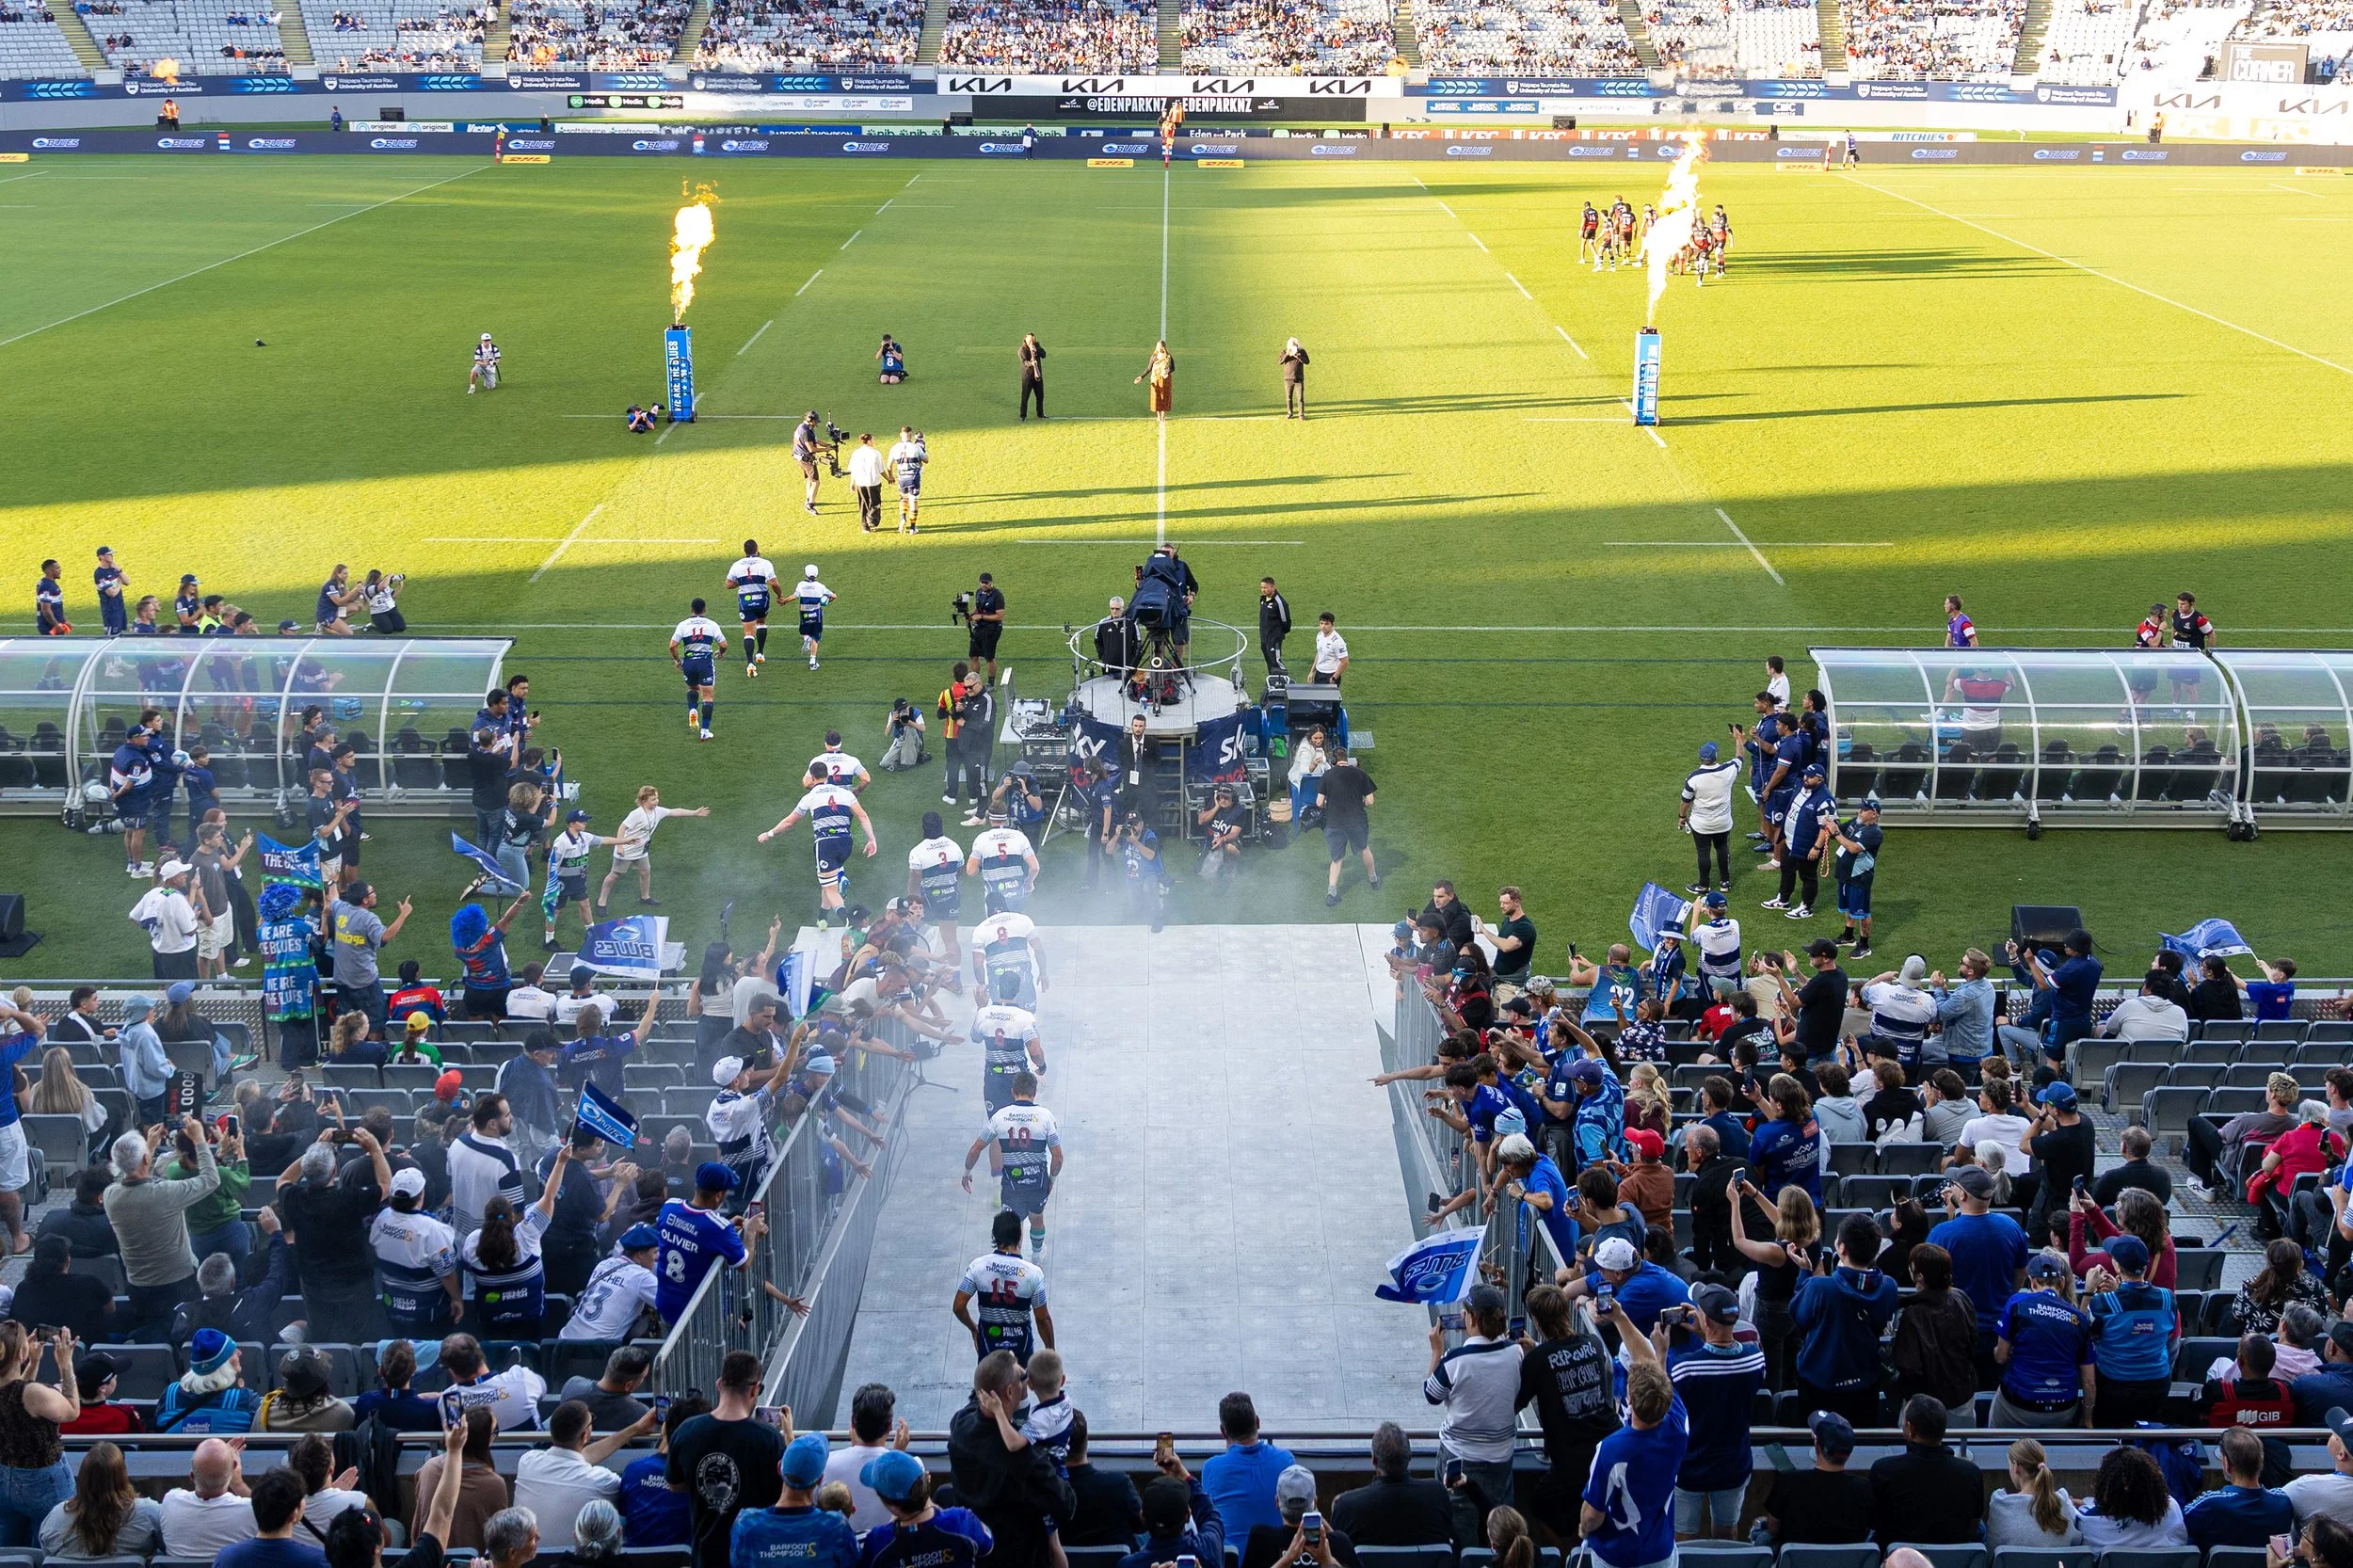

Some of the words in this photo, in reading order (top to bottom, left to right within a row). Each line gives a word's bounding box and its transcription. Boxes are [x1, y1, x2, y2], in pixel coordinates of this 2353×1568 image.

[949, 78, 1012, 92] KIA
[1063, 78, 1124, 92] KIA
[1193, 79, 1255, 93] KIA
[1310, 80, 1371, 94] KIA
[1087, 98, 1167, 112] @EDENPARKNZ
[2154, 93, 2221, 108] KIA
[2279, 99, 2348, 114] KIA
[1190, 129, 1211, 137] Eden
[1225, 129, 1247, 137] Park
[47, 138, 81, 148] BLUES
[172, 138, 206, 149] BLUES
[263, 138, 297, 148] BLUES
[384, 138, 418, 148] BLUES
[522, 140, 555, 149] BLUES
[857, 143, 889, 152] BLUES
[993, 143, 1024, 152] BLUES
[1115, 143, 1149, 152] BLUES
[1206, 144, 1238, 153] BLUES
[1324, 145, 1357, 154] BLUES
[1460, 146, 1493, 155] BLUES
[1582, 147, 1615, 155] BLUES
[1790, 148, 1823, 156] BLUES
[1925, 149, 1958, 158] BLUES
[2047, 150, 2080, 159] BLUES
[2137, 151, 2169, 160] BLUES
[2255, 152, 2287, 161] BLUES
[887, 358, 893, 367] 8
[692, 628, 705, 642] 11
[831, 765, 841, 782] 2
[828, 795, 838, 813] 4
[1212, 820, 1231, 835] sky
[998, 843, 1008, 861] 5
[264, 853, 284, 868] THE
[938, 852, 949, 868] 3
[273, 923, 294, 938] ARE
[181, 1072, 195, 1106] GOOD
[662, 1229, 698, 1253] OLIVIER
[666, 1250, 685, 1283] 8
[992, 1262, 1019, 1272] BARFOOT
[1404, 1249, 1474, 1288] BLUES
[503, 1288, 528, 1297] HELLO
[991, 1277, 1019, 1304] 15
[393, 1297, 416, 1305] HELLO
[502, 1293, 528, 1302] FRESH
[393, 1303, 416, 1311] FRESH
[2037, 1304, 2072, 1317] BARFOOT
[2028, 1308, 2072, 1322] THOMPSON
[1548, 1350, 1572, 1368] RIP
[1573, 1341, 1597, 1362] CURL
[2258, 1411, 2281, 1422] GIB
[770, 1544, 808, 1552] BARFOOT
[759, 1549, 807, 1559] THOMPSON
